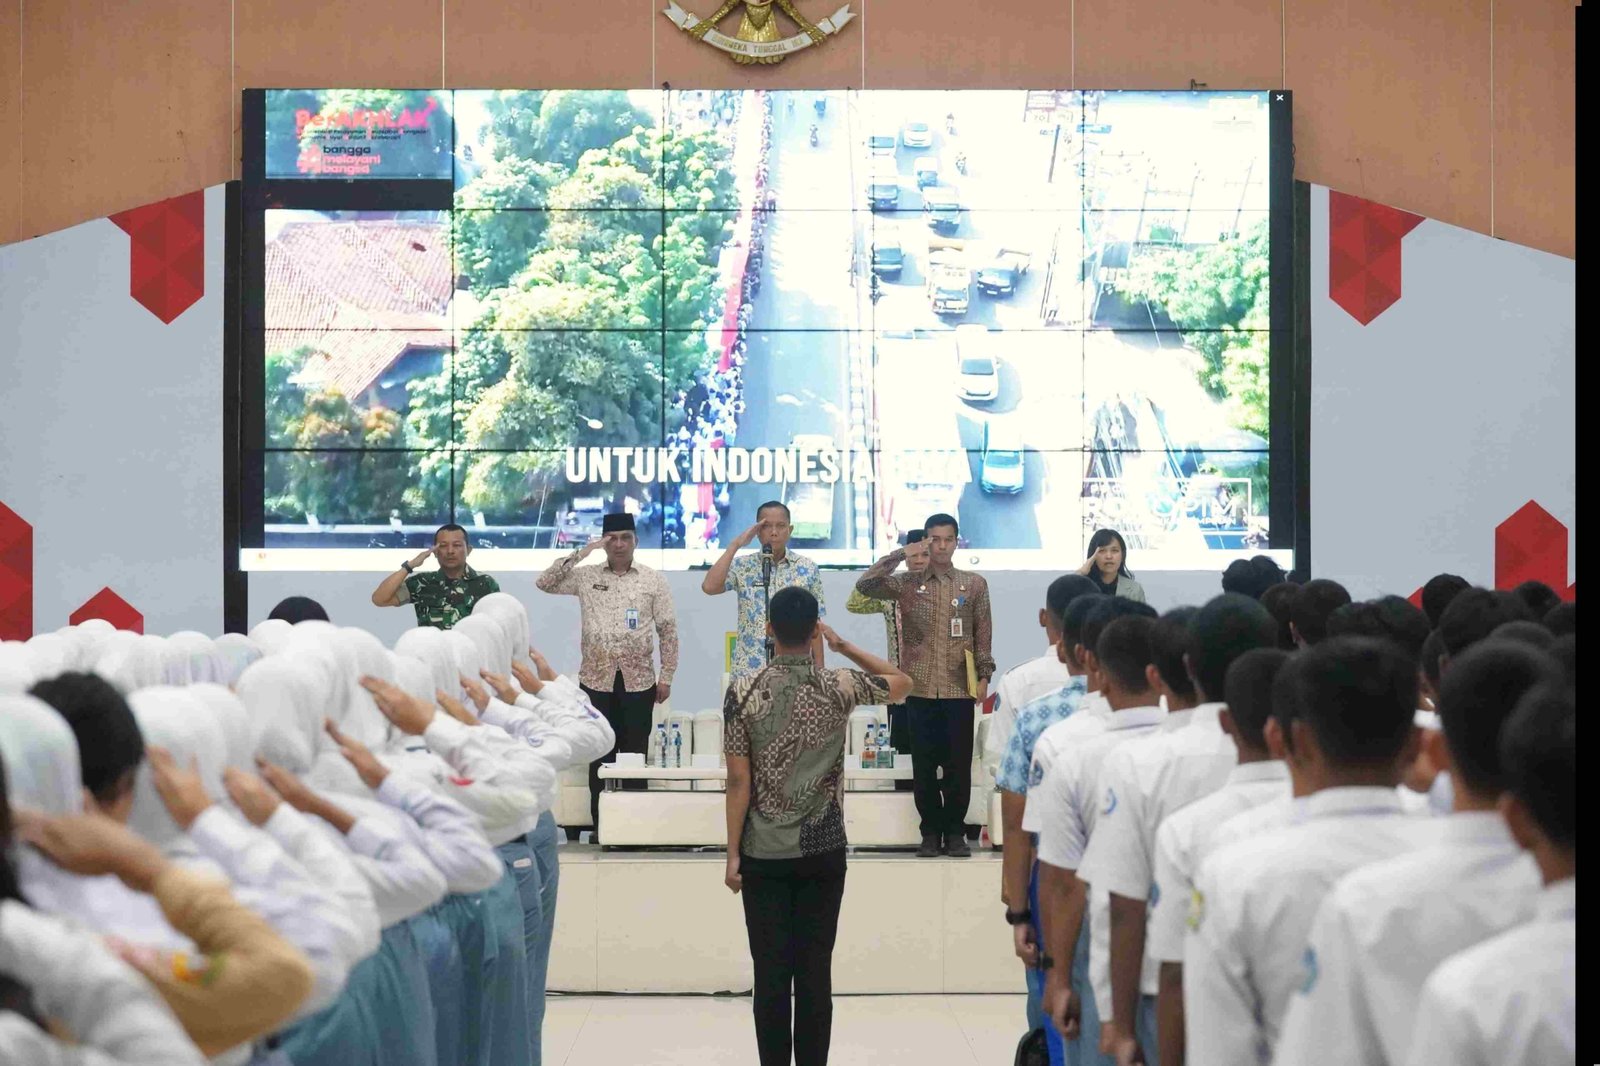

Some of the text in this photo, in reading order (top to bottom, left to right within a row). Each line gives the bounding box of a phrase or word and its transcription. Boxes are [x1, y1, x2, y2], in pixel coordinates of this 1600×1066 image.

[323, 145, 372, 157] bangga
[565, 446, 681, 483] UNTUK
[692, 446, 875, 483] INDONESIA
